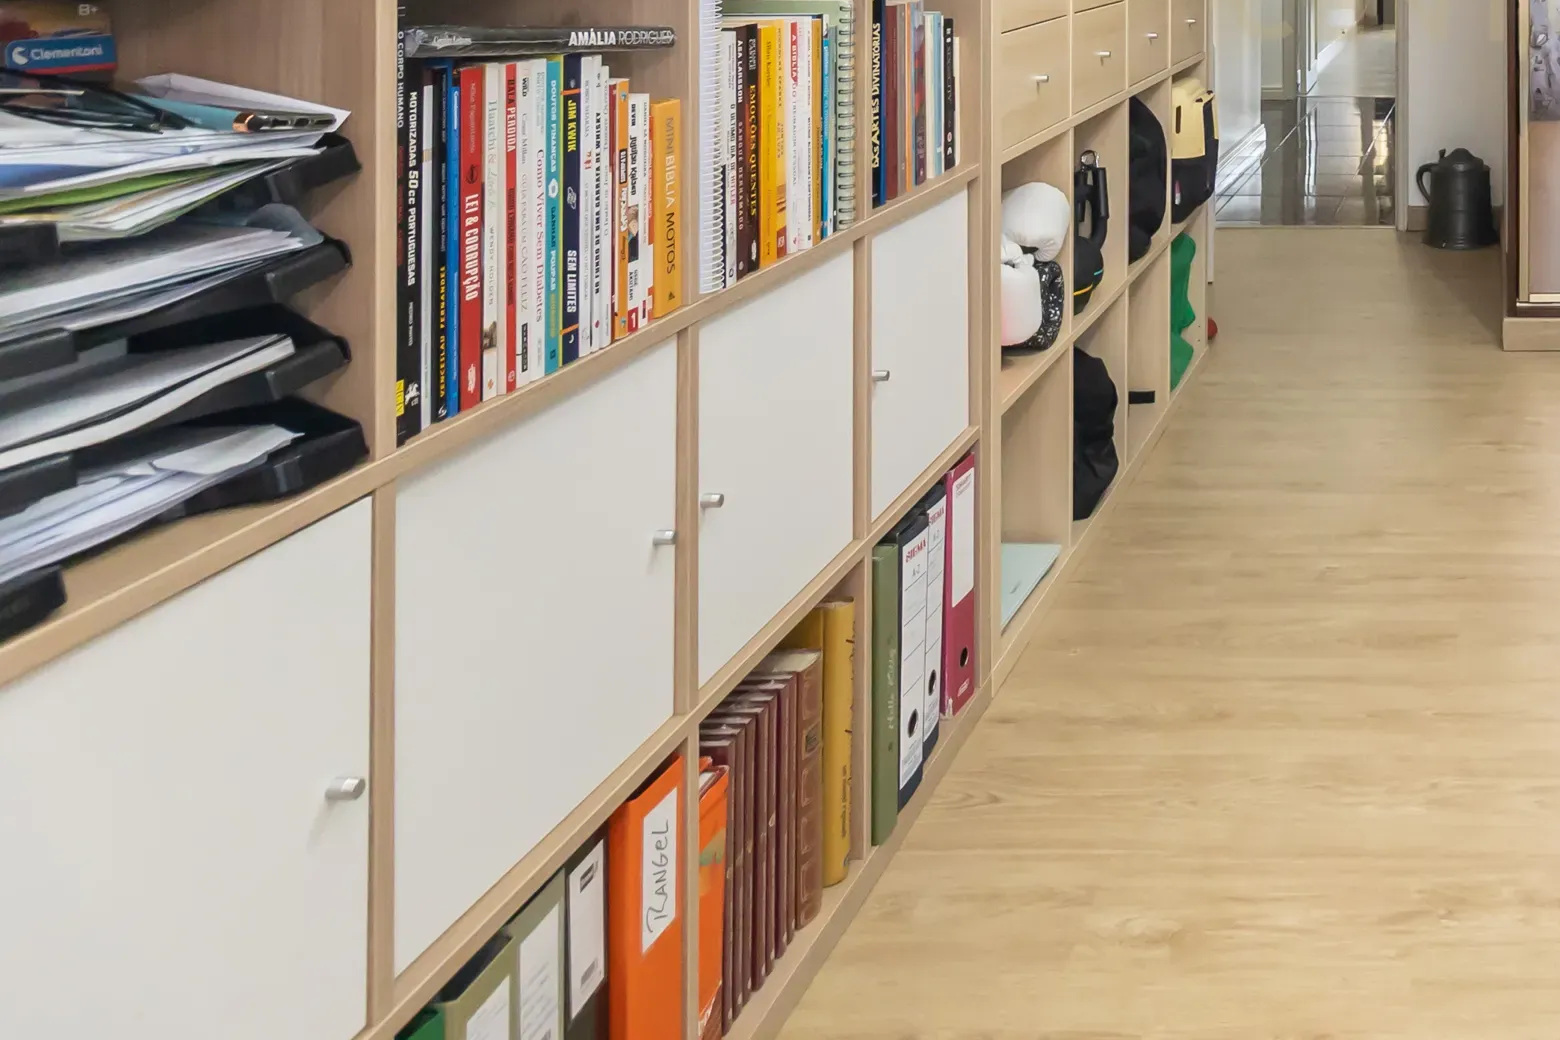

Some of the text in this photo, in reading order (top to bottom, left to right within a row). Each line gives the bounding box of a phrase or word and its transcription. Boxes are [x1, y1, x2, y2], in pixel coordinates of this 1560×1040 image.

[31, 43, 103, 62] Clementoni
[397, 30, 404, 41] O
[568, 28, 675, 47] AMÁLIA RODRIGUES
[871, 22, 880, 145] ARTES DIVINATÓRIAS
[507, 79, 516, 152] BALA PERDIDA
[567, 99, 577, 153] JIM KWIK
[549, 123, 557, 173] FINANÇAS
[595, 150, 601, 163] DE
[730, 162, 736, 173] DE
[748, 84, 757, 217] EMOÇÕES QUENTES
[407, 91, 419, 286] MOTORIZADAS 50cc PORTUGUESAS
[462, 193, 481, 301] LEI & CORRUPÇÃO
[536, 149, 545, 323] Como Viver Sem Diabetes
[595, 234, 601, 246] DE
[665, 211, 676, 275] MOTOS
[567, 249, 577, 313] SEM LIMITES
